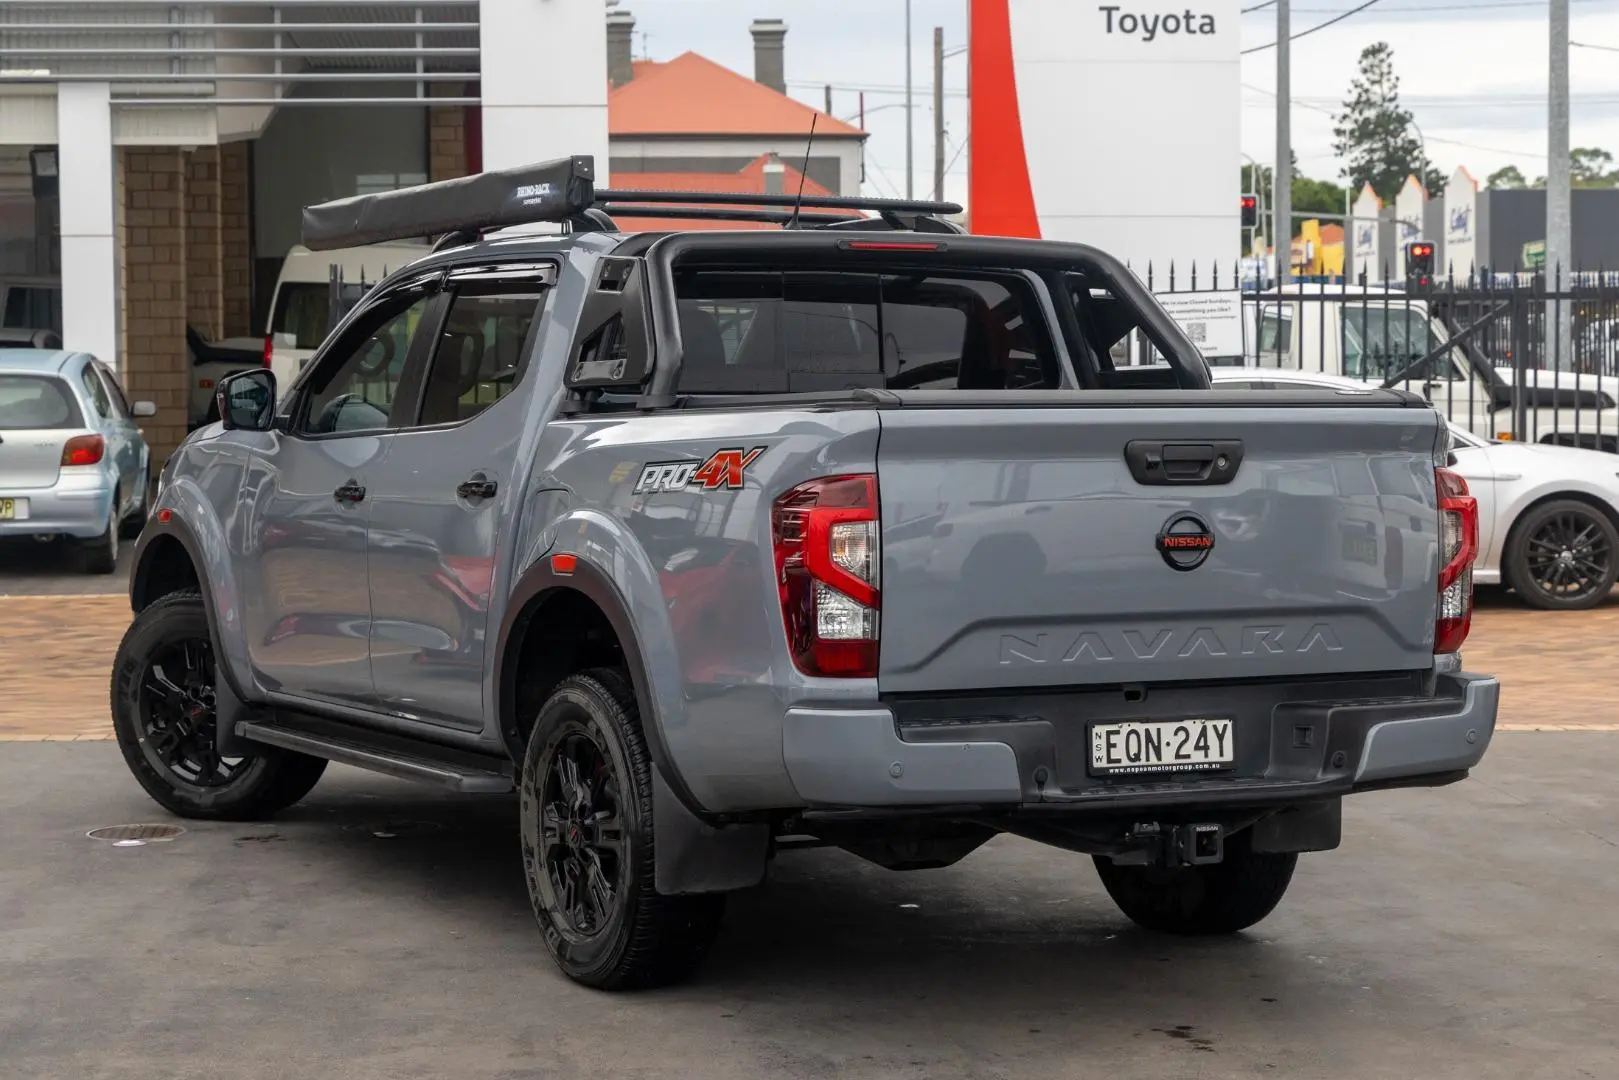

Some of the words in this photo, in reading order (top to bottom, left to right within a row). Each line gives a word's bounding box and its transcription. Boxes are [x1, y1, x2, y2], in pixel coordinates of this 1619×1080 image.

[1098, 6, 1216, 41] Toyota
[516, 183, 550, 198] RHINO-RACK
[634, 446, 768, 493] PRO-4X
[1164, 536, 1212, 547] NISSAN
[999, 622, 1343, 664] NAVARA
